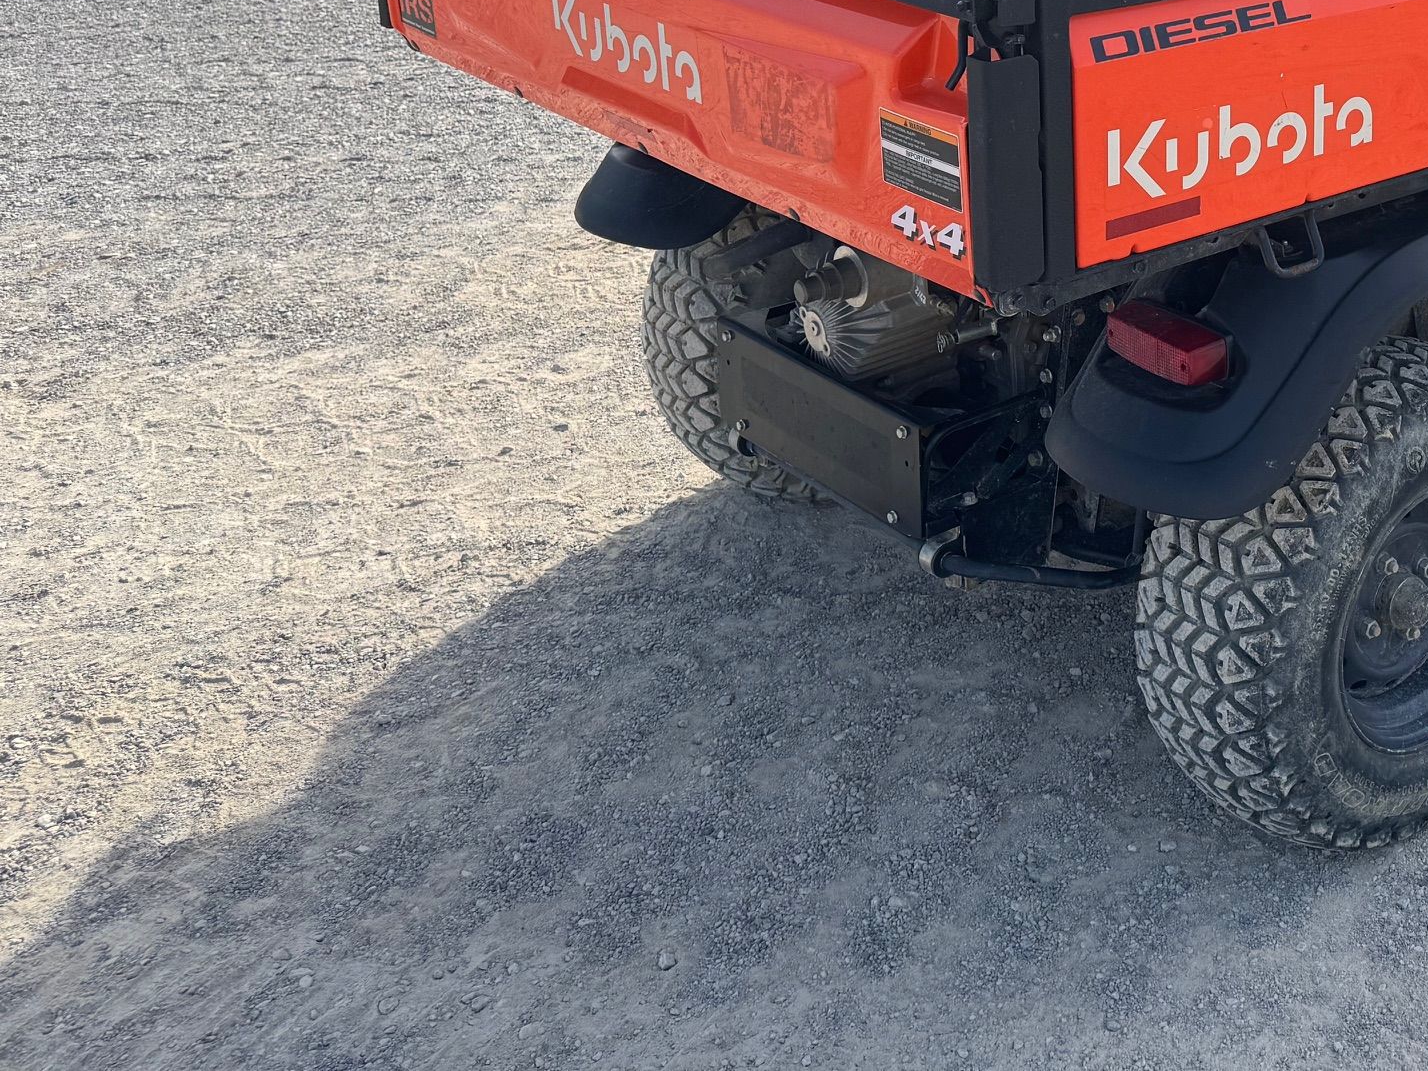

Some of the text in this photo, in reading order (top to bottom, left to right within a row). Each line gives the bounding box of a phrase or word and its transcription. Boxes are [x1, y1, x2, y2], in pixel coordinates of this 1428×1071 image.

[1089, 0, 1312, 63] DIESEL
[908, 121, 932, 136] WARNING
[1107, 84, 1373, 198] Kubota
[905, 150, 933, 166] IMPORTANT
[891, 205, 965, 259] 4x4
